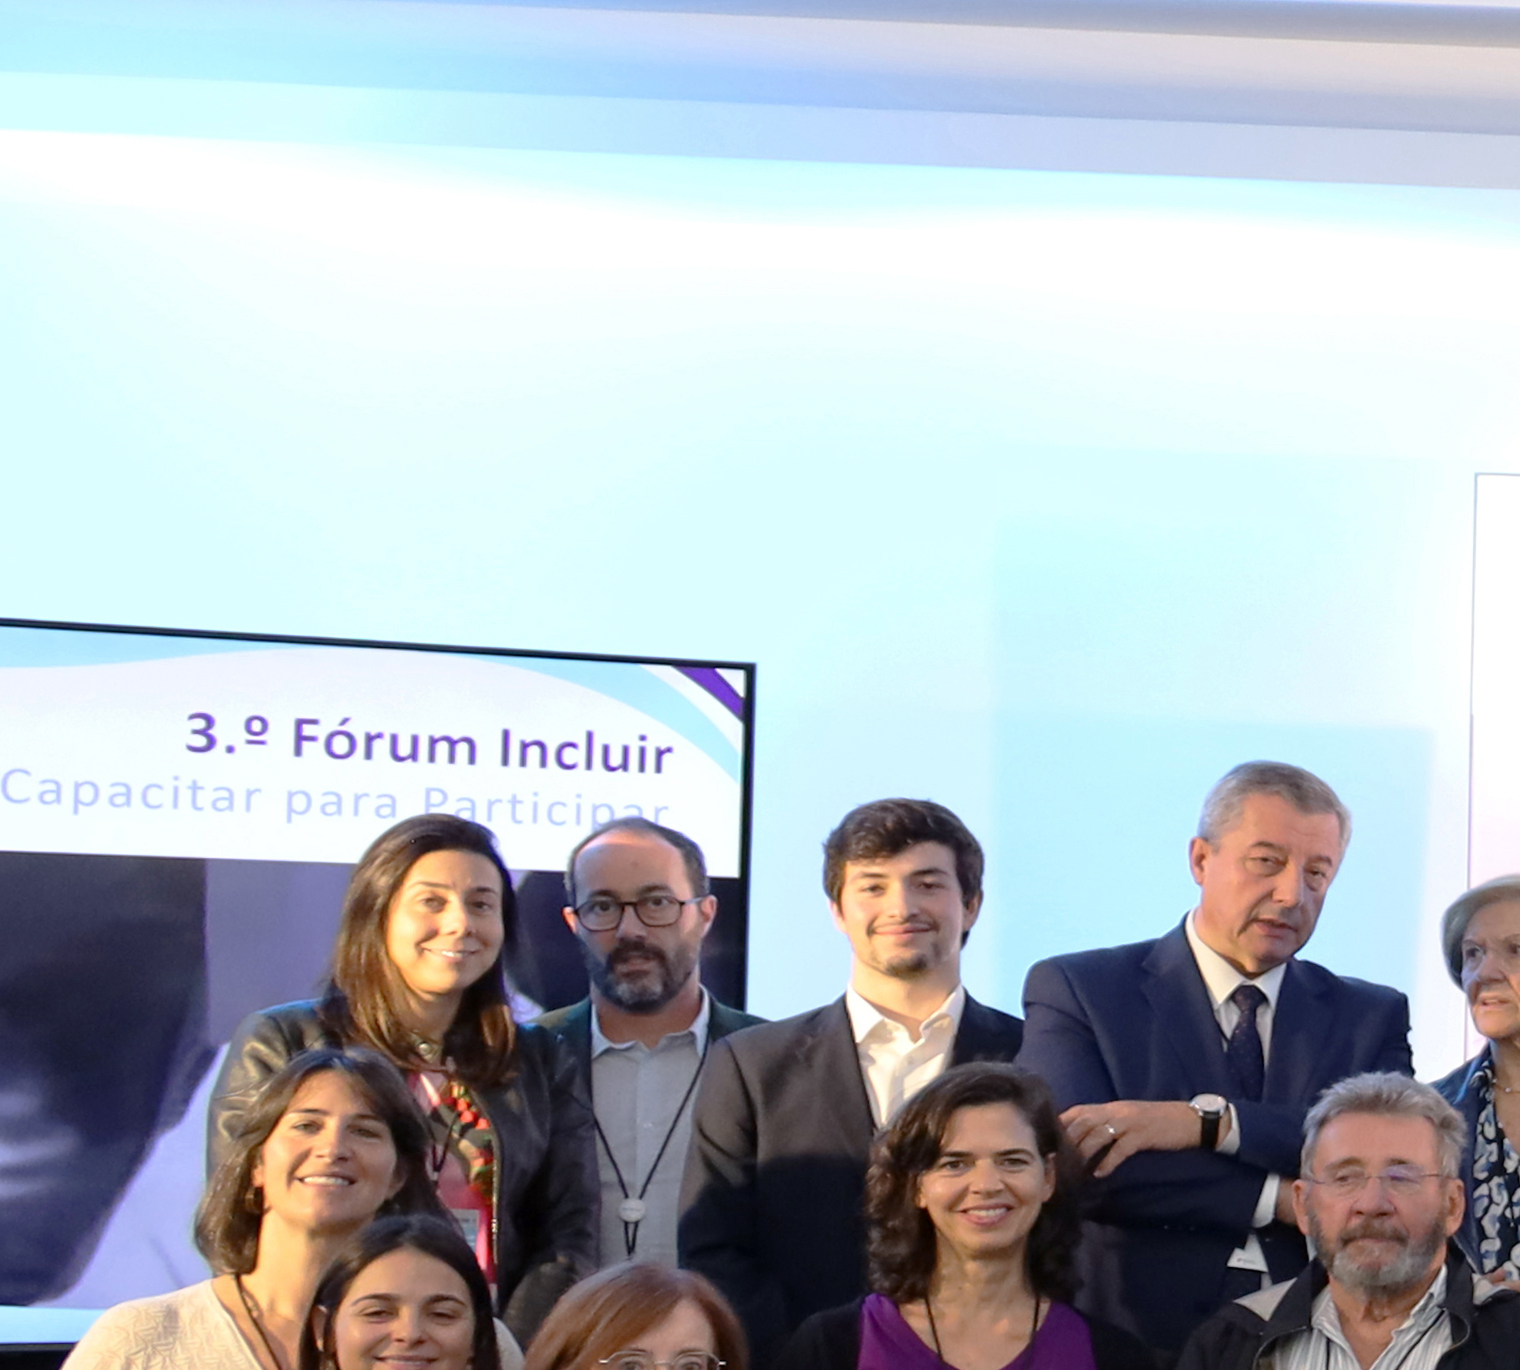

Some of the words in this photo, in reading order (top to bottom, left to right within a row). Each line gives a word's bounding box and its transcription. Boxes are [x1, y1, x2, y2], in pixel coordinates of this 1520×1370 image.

[291, 717, 479, 766] Fórum
[500, 728, 675, 775] Incluir
[0, 767, 264, 818] Capacitar
[285, 786, 399, 824] para
